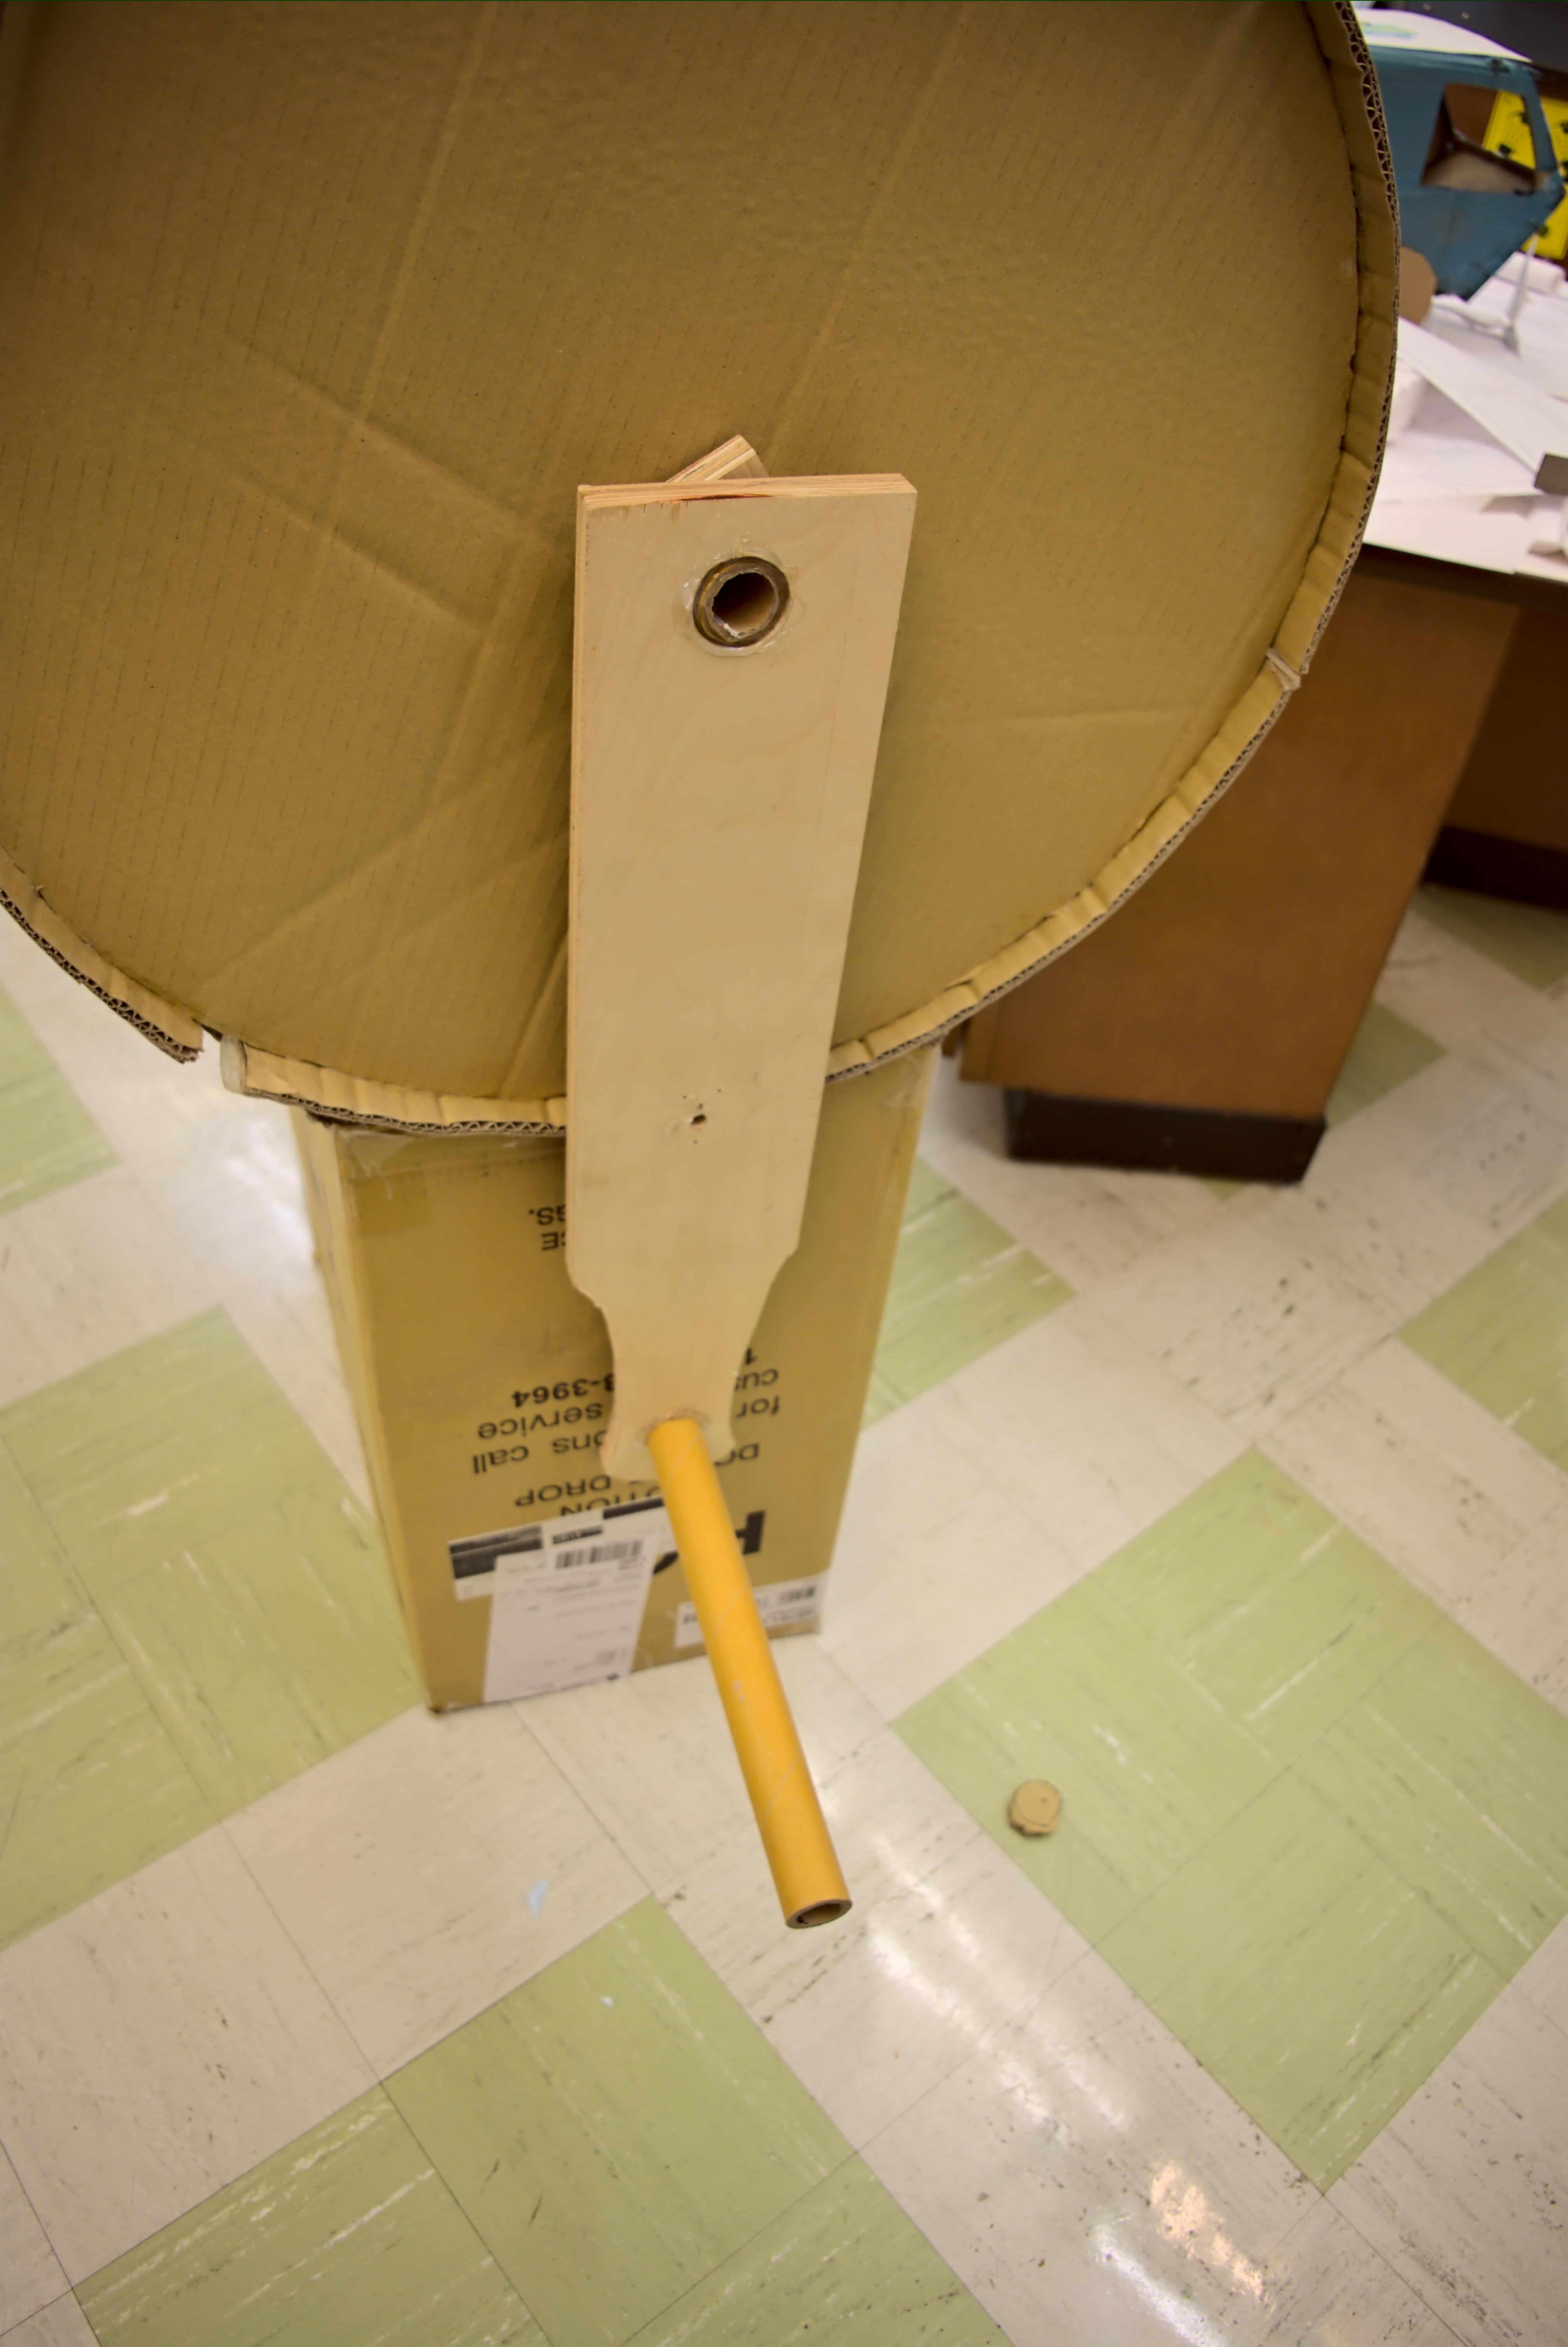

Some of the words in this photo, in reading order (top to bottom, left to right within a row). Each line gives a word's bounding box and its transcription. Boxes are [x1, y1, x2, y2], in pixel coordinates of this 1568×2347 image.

[478, 1403, 602, 1440] service
[735, 1396, 780, 1419] for
[472, 1445, 528, 1474] call
[514, 1475, 611, 1507] DROP
